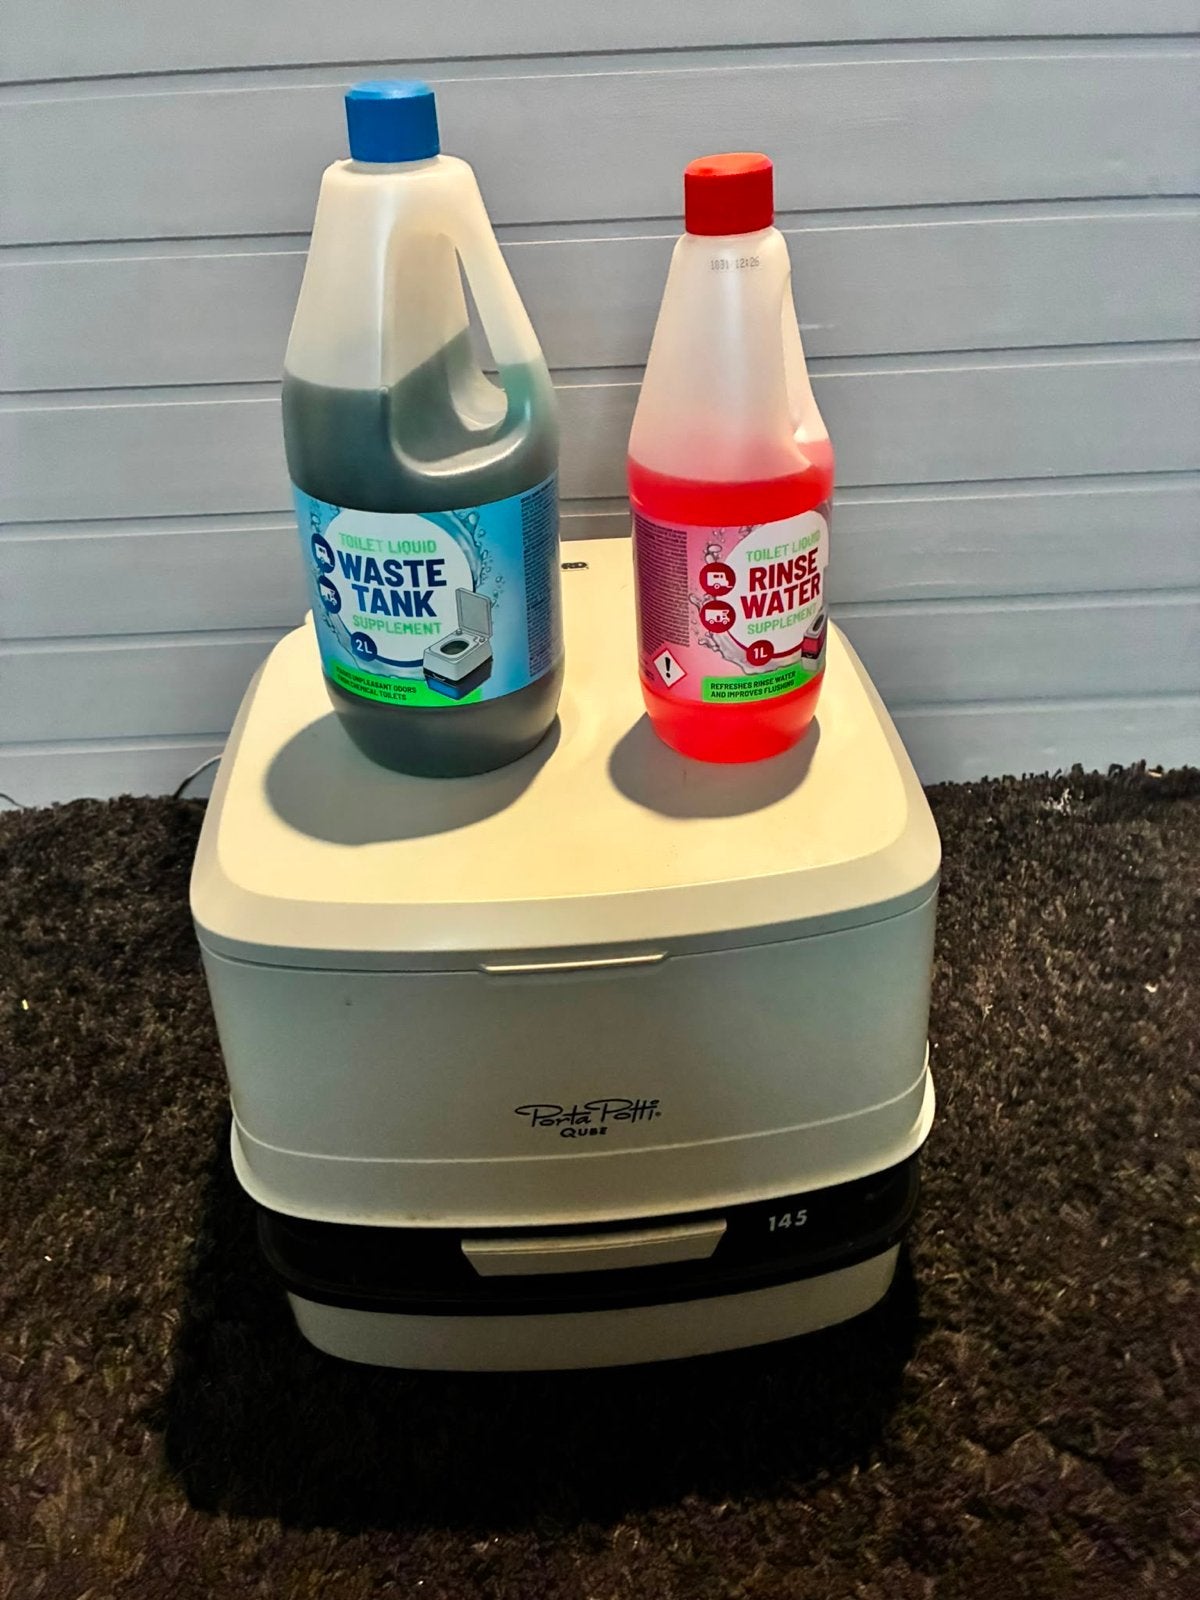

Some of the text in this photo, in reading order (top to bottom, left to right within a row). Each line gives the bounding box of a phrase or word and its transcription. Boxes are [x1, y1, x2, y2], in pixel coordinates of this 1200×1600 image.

[339, 532, 437, 555] TOILET LIQUID
[746, 530, 821, 562] TOILET LIQUID
[337, 550, 447, 588] WASTE
[749, 547, 819, 592] RINSE
[351, 583, 437, 618] TANK
[740, 573, 821, 620] WATER
[353, 614, 442, 635] SUPPLEMENT
[747, 603, 817, 635] SUPPLEMENT
[355, 639, 373, 655] 2L
[754, 647, 768, 660] 1L
[393, 684, 416, 694] ODORS
[711, 671, 796, 690] REFRESHES RINSE WATER
[727, 689, 763, 698] IMPROVES
[763, 680, 795, 694] FLUSHING
[380, 690, 407, 701] TOILETS
[515, 1098, 660, 1128] Porta Potti
[560, 1126, 608, 1138] QUBE
[768, 1209, 808, 1232] 145
